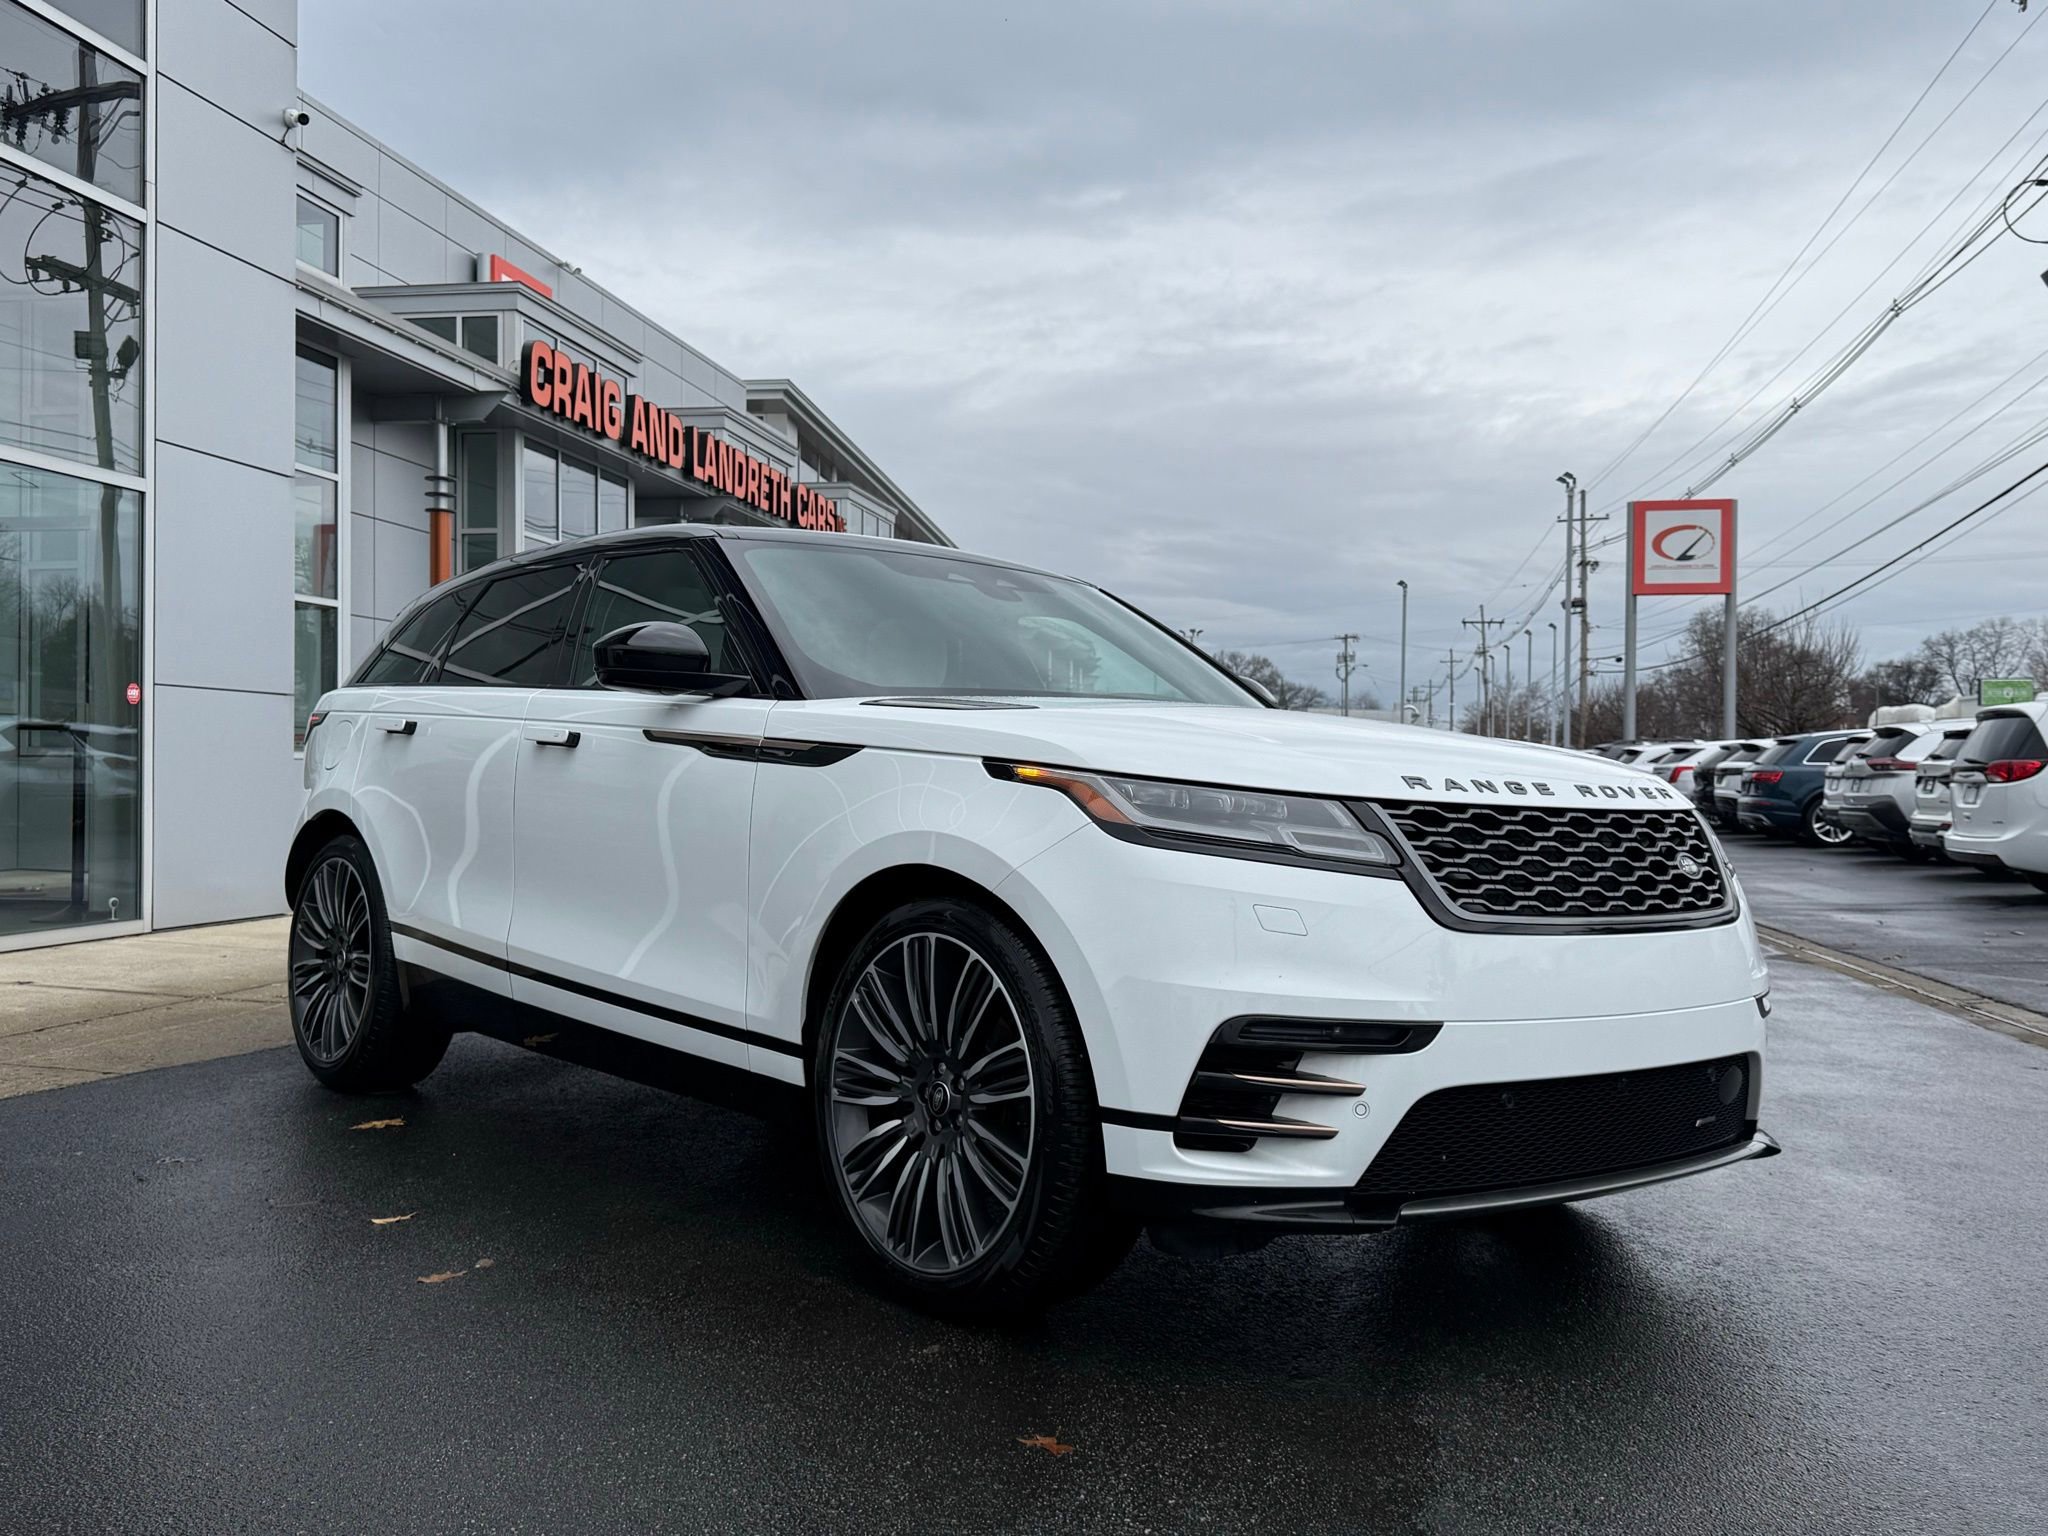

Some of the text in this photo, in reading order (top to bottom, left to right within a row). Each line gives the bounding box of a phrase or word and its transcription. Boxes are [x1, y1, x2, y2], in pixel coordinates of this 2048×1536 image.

[529, 340, 836, 532] CRAIG AND LANDRETH CARS
[1400, 775, 1674, 800] RANGE ROVER
